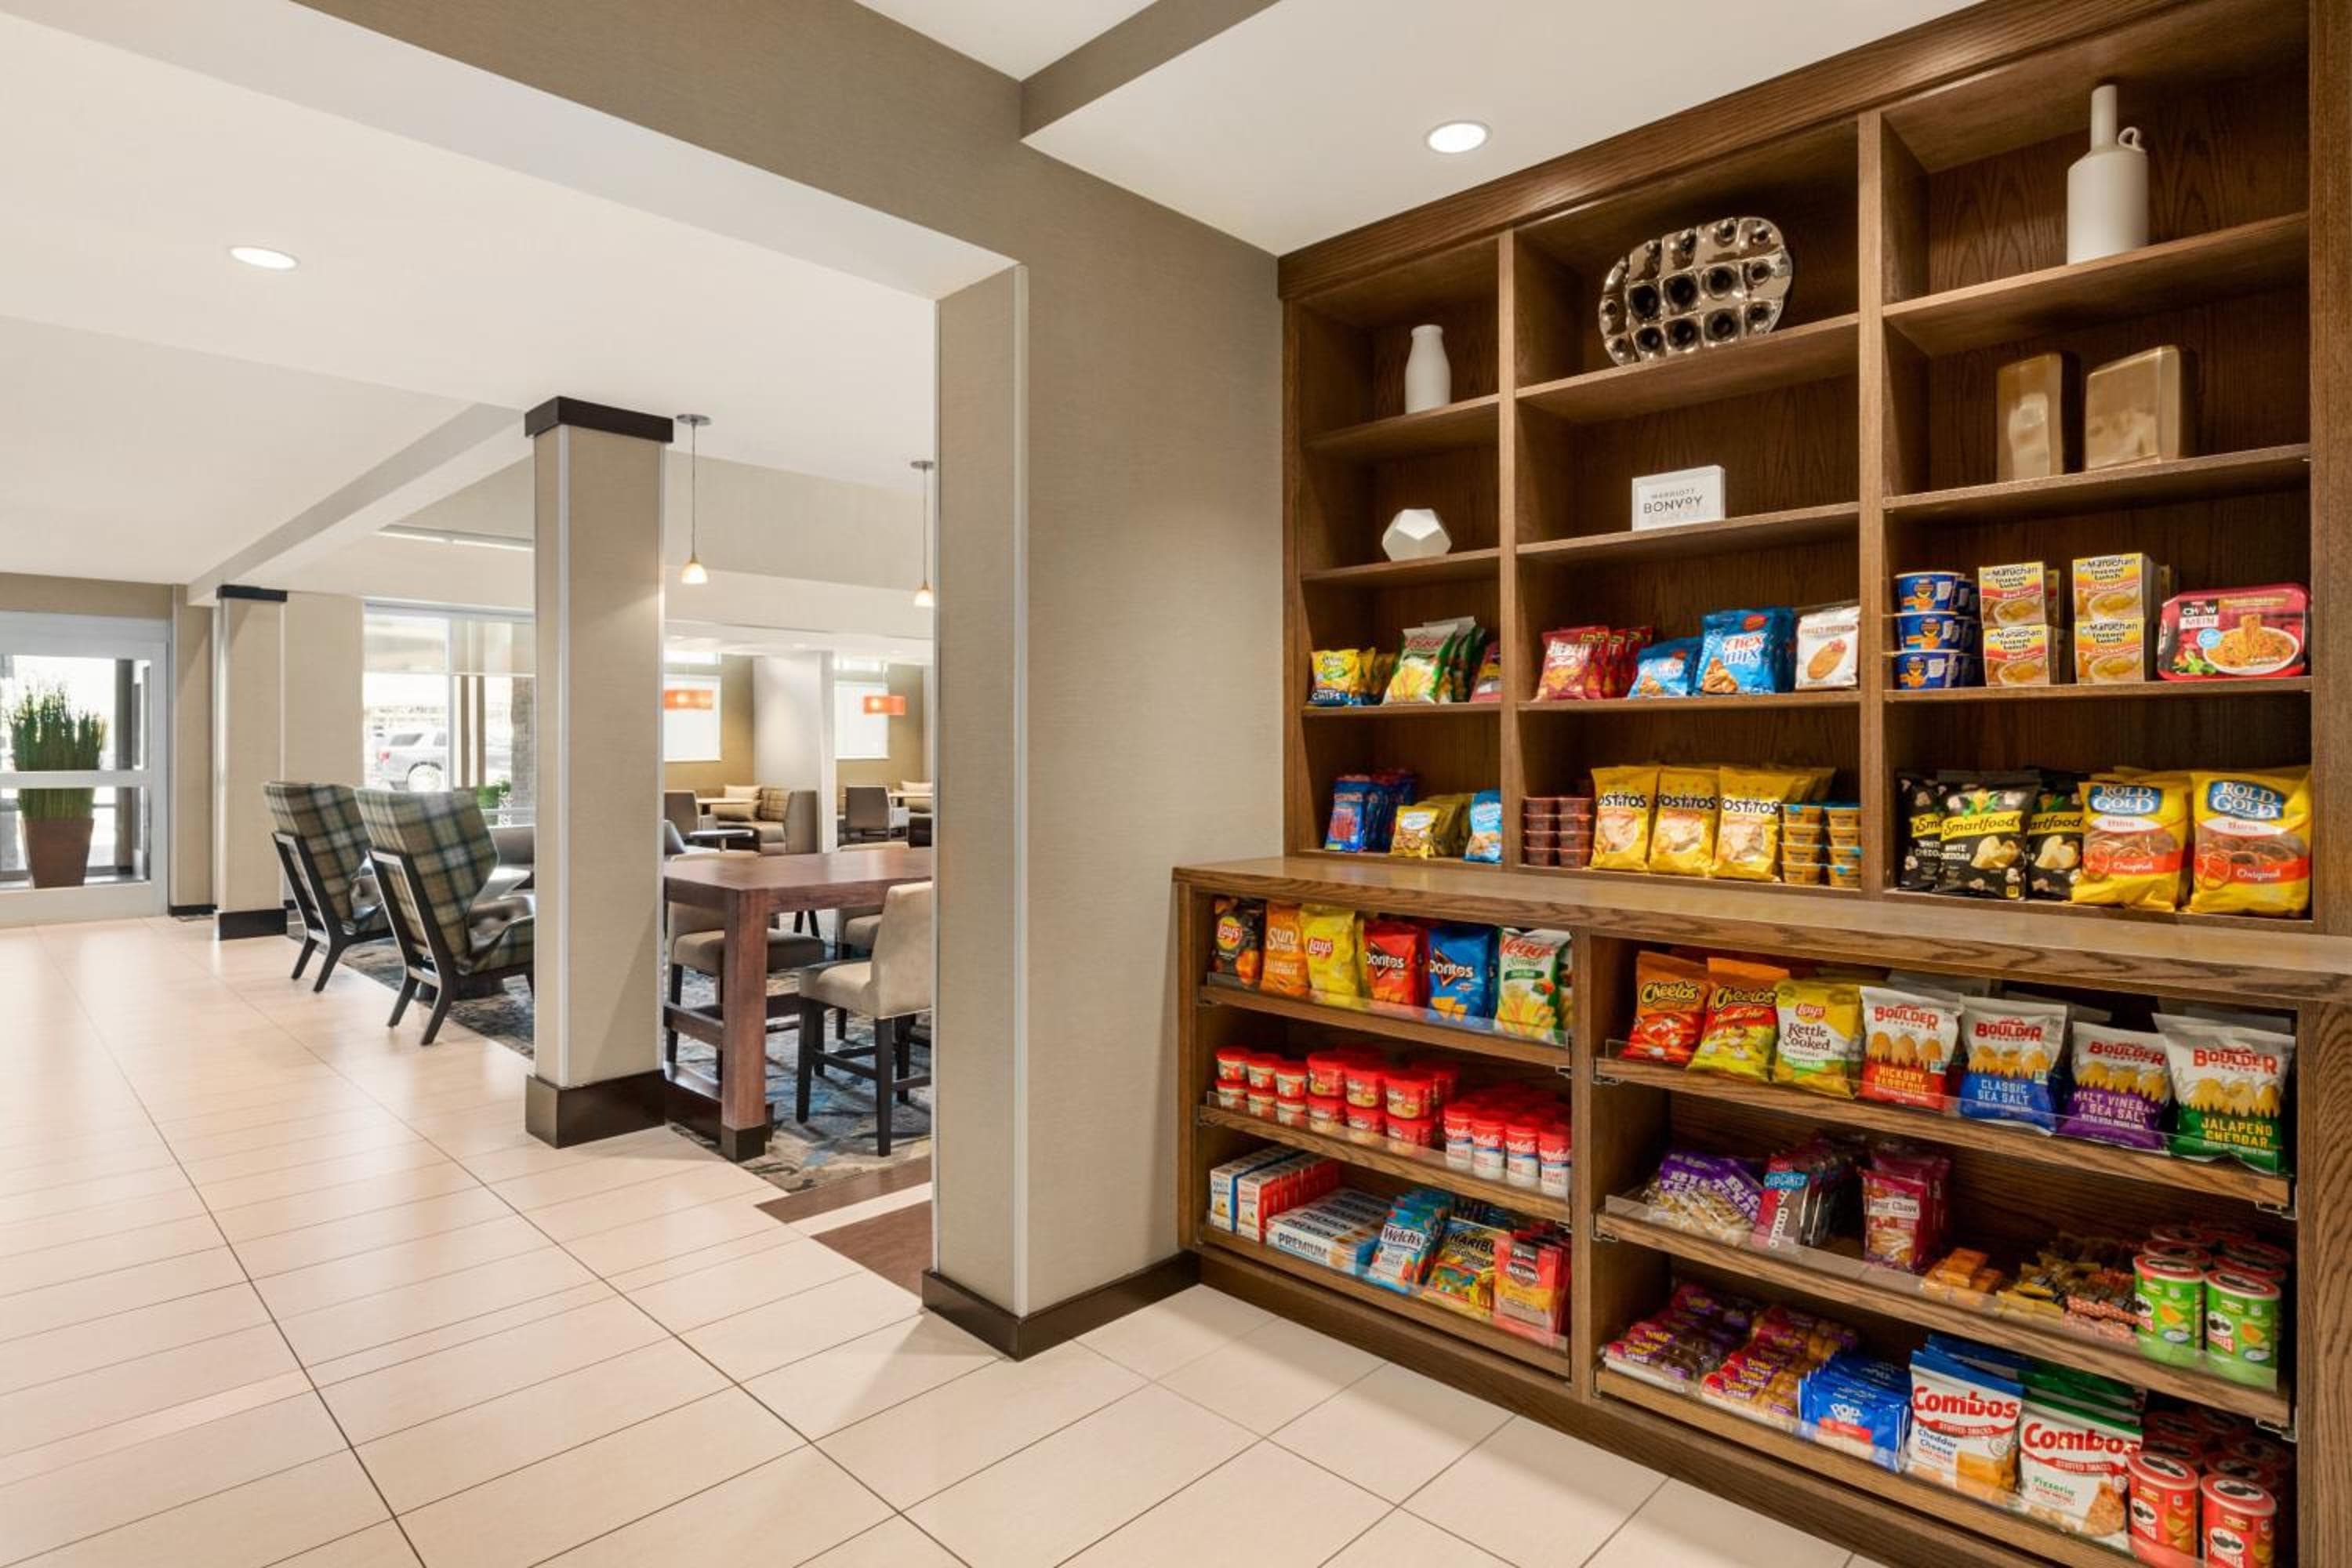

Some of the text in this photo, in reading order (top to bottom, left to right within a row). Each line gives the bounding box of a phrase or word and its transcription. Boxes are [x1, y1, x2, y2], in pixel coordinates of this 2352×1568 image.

[1651, 488, 1694, 499] MARRIOTT
[1643, 495, 1703, 514] BONVOY
[1993, 566, 2038, 576] Maruchan
[2088, 557, 2136, 566] Maruchan
[2089, 622, 2137, 631] Maruchan
[1725, 636, 1763, 652] Chex
[1726, 649, 1758, 663] mix
[2103, 786, 2152, 797] ROLD
[2220, 782, 2276, 803] ROLD
[2092, 797, 2154, 811] GOLD
[2212, 795, 2278, 818] GOLD
[1944, 816, 2016, 836] Smartfood
[2237, 869, 2281, 880] Original
[1267, 927, 1294, 950] Sun
[1308, 938, 1333, 958] Lay's
[1367, 949, 1405, 969] Doritos
[1430, 960, 1473, 978] Doritos
[1641, 982, 1698, 1004] Cheetos
[1713, 987, 1776, 1011] Cheetos
[1797, 1004, 1824, 1018] Lay's
[1875, 1006, 1939, 1030] BOULDER
[1788, 1023, 1828, 1038] Kettle
[1976, 1022, 2042, 1043] BOULDER
[1784, 1036, 1831, 1051] Cooked
[2089, 1041, 2166, 1067] BOULDER
[2194, 1050, 2278, 1076] BOULDER
[1981, 1079, 2027, 1094] CLASSIC
[1978, 1090, 2029, 1105] SEA SALT
[2074, 1091, 2103, 1102] MALT
[2089, 1104, 2113, 1116] SEA
[2117, 1109, 2147, 1125] SALT
[2205, 1130, 2268, 1149] CHEDDAR
[1892, 1200, 1917, 1213] Claw
[1279, 1232, 1328, 1257] PREMIUM
[1384, 1227, 1421, 1248] Welch's
[1912, 1386, 2019, 1419] Combos
[1918, 1428, 1958, 1449] Cheddar
[2024, 1422, 2140, 1454] Combos
